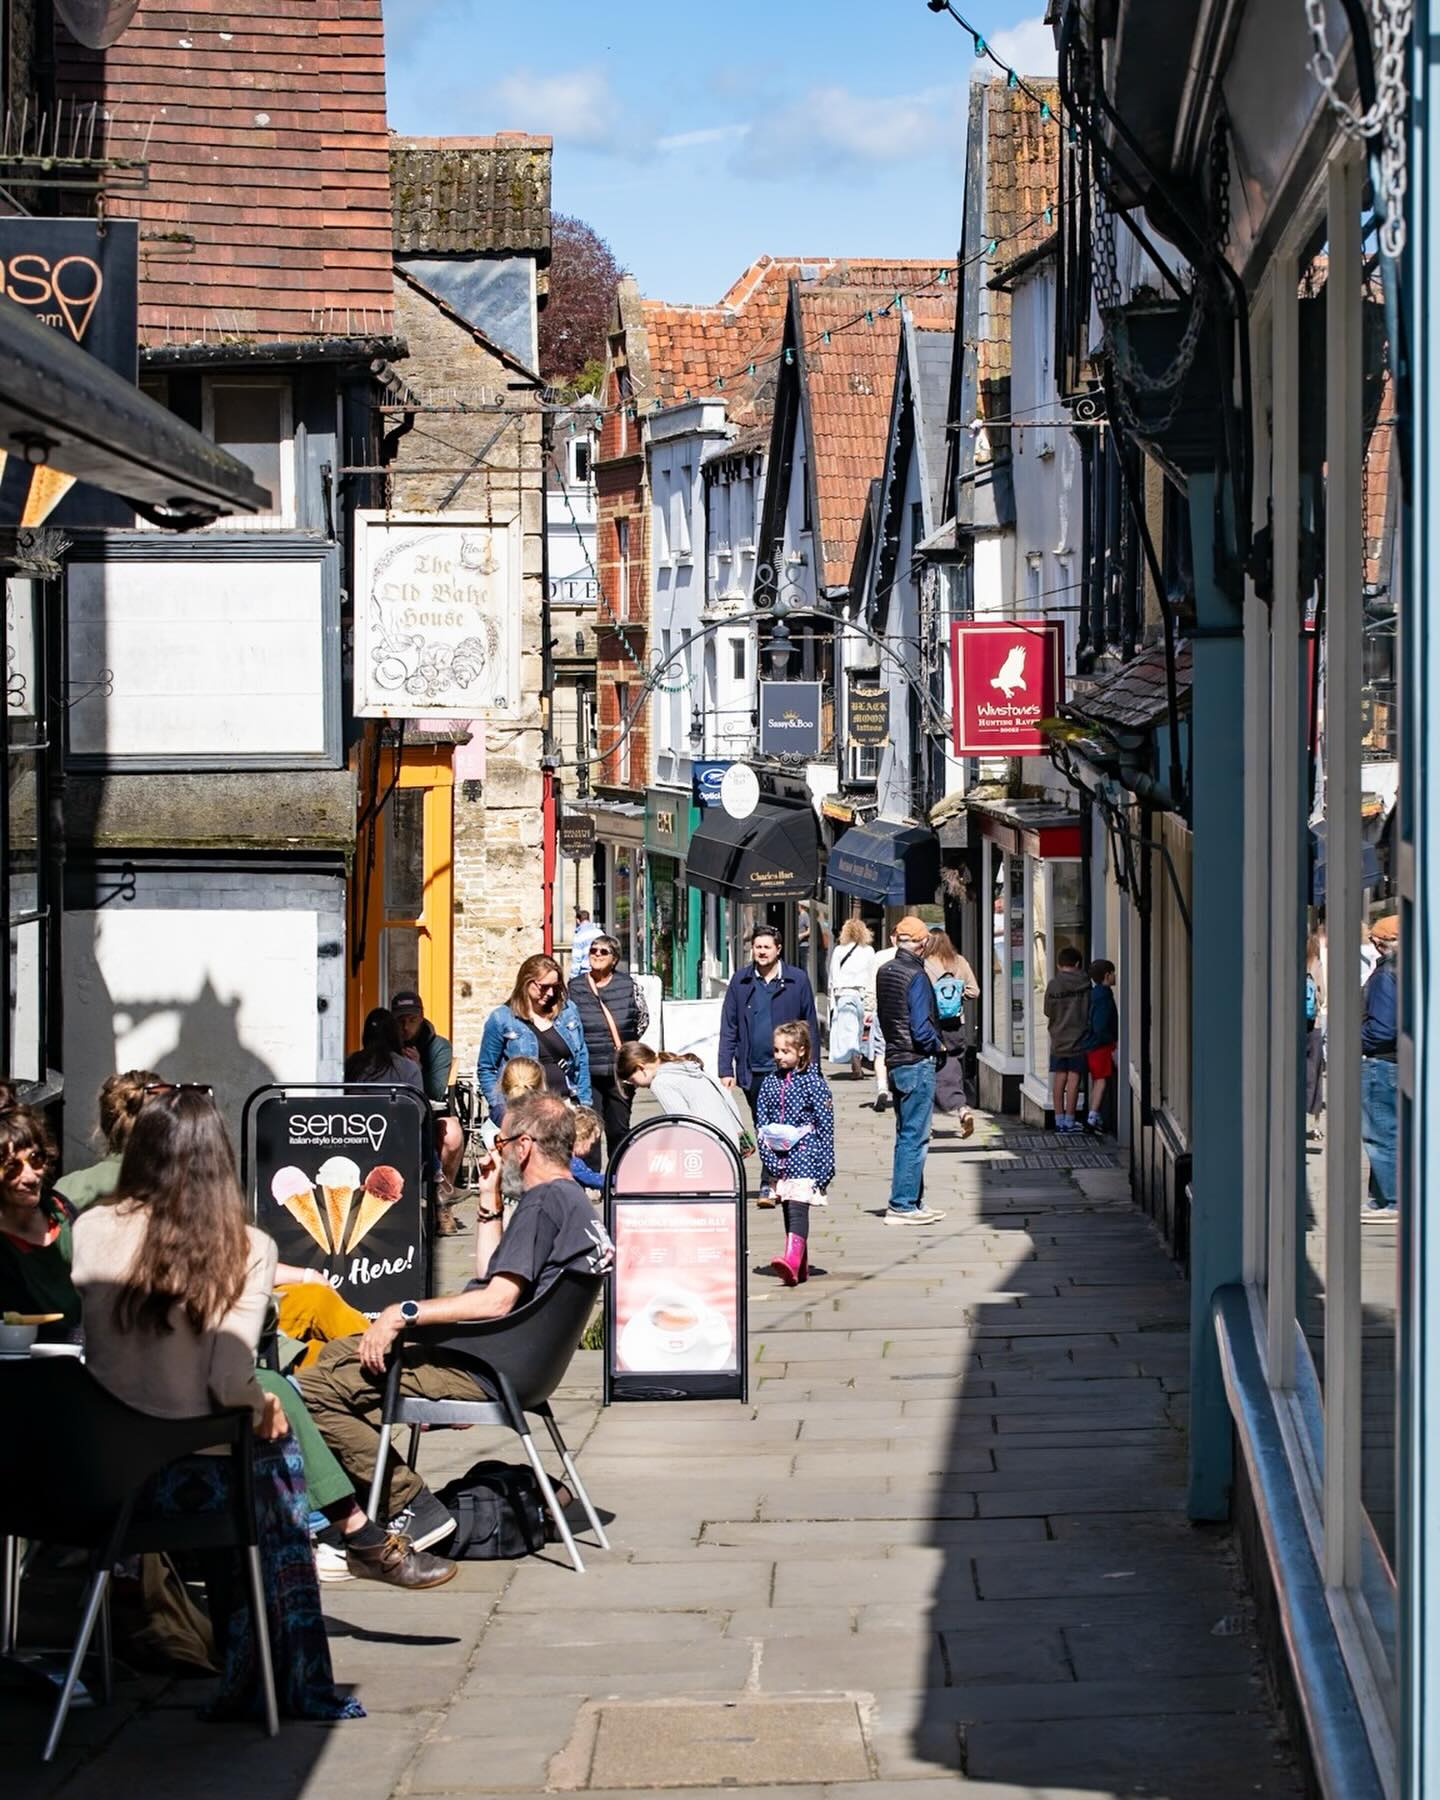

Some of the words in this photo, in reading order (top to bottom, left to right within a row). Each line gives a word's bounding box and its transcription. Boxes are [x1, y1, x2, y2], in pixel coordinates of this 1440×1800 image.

[414, 554, 452, 576] The
[381, 582, 421, 603] Old
[432, 583, 489, 606] Bake
[399, 607, 464, 628] House
[850, 702, 889, 712] BLACK
[977, 702, 1041, 716] Winstone's
[852, 713, 886, 724] MOON
[750, 871, 778, 881] Charles
[778, 869, 795, 880] Hart
[348, 1245, 415, 1285] Here!
